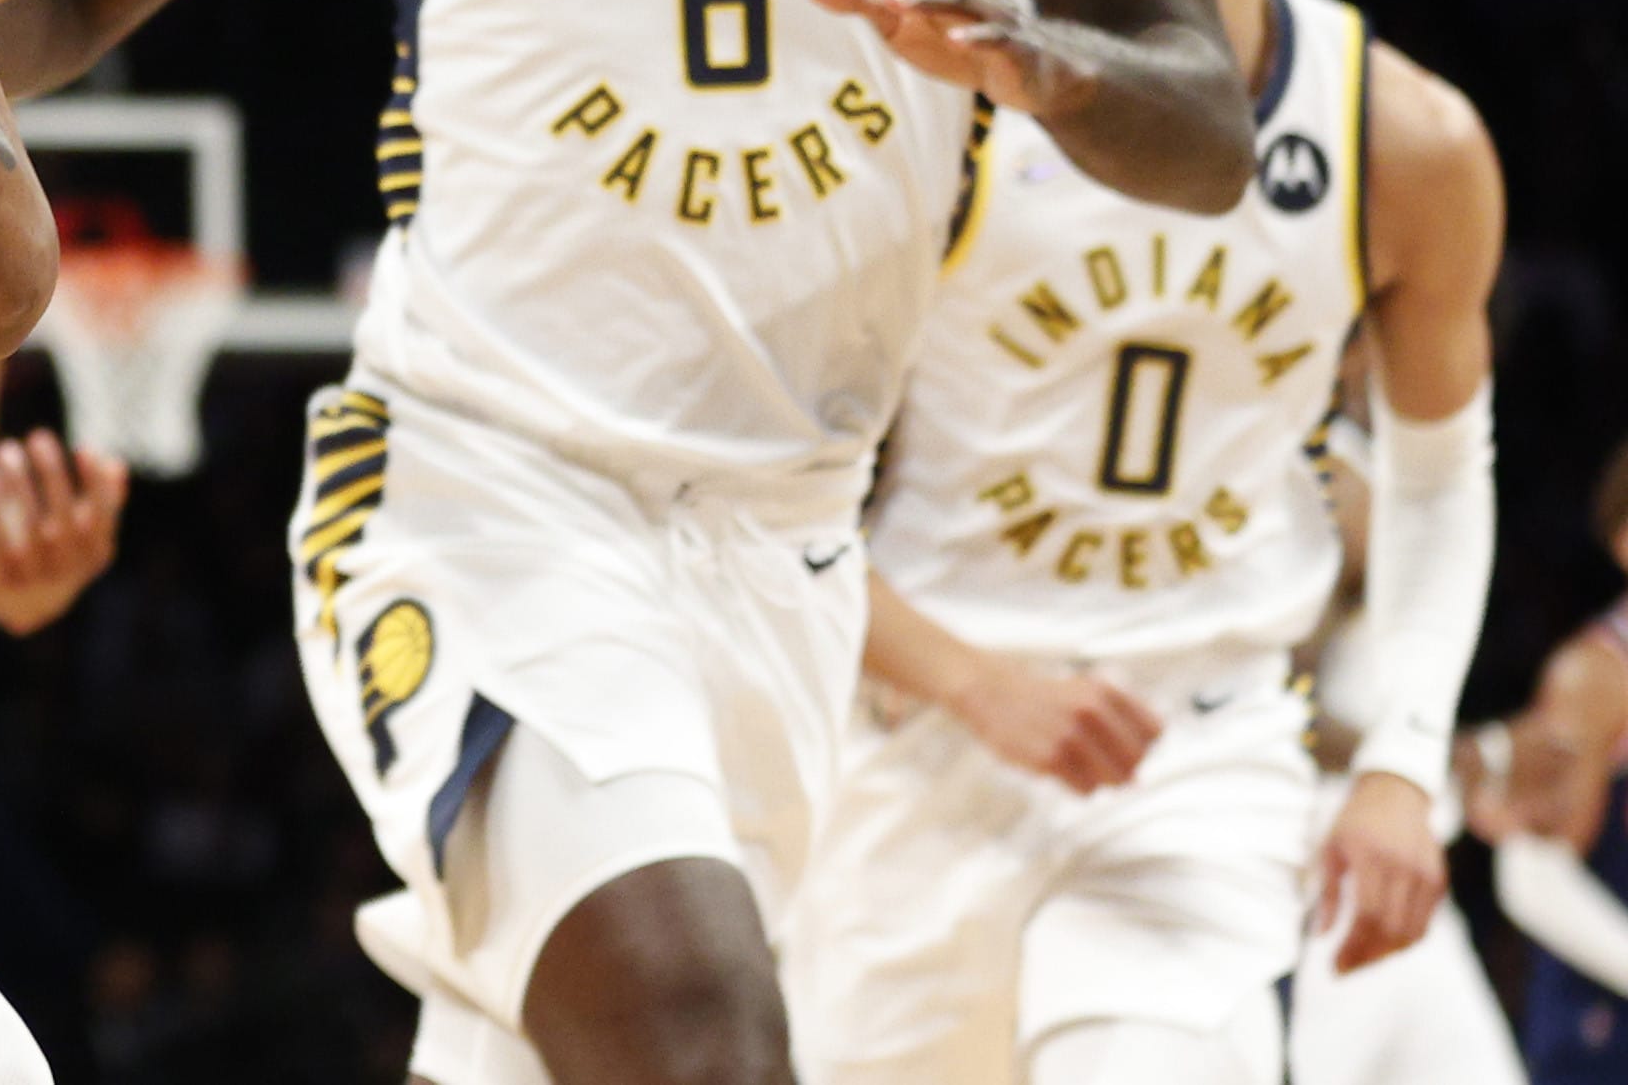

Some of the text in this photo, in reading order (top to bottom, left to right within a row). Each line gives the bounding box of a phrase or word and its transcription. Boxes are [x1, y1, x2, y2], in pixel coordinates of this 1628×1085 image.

[550, 77, 895, 225] PACERS
[986, 232, 1316, 389] INDIANA
[1096, 339, 1192, 499] 0
[976, 472, 1250, 590] PACERS
